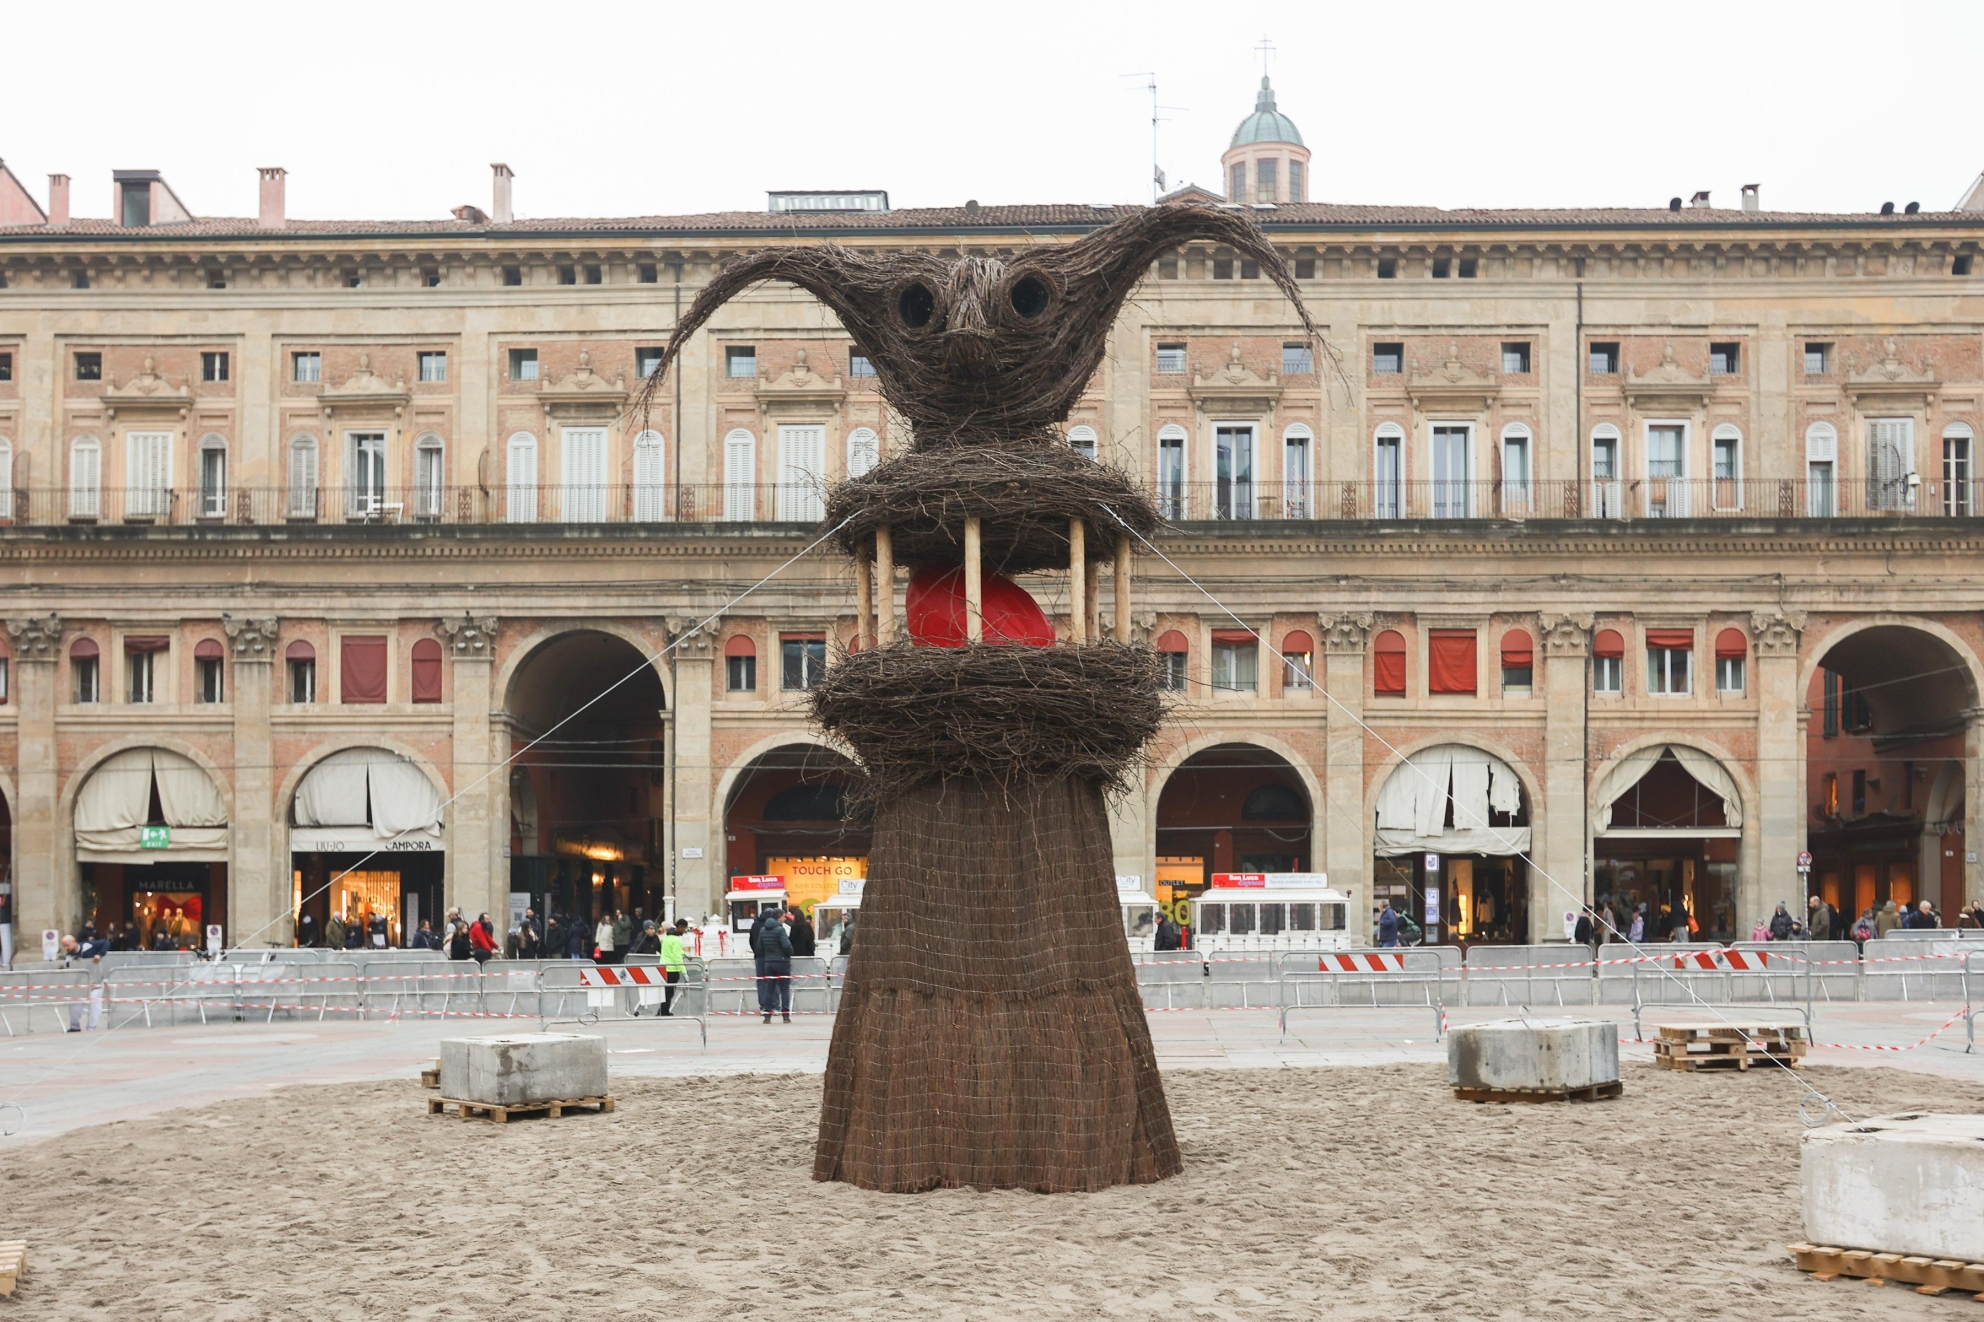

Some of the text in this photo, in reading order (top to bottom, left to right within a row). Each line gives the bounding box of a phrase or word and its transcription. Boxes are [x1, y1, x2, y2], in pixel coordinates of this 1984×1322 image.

[385, 841, 431, 851] CAMPORA
[792, 866, 853, 875] TOUCH GO
[139, 880, 194, 890] MARELLA
[1120, 875, 1135, 885] City
[841, 880, 858, 891] City
